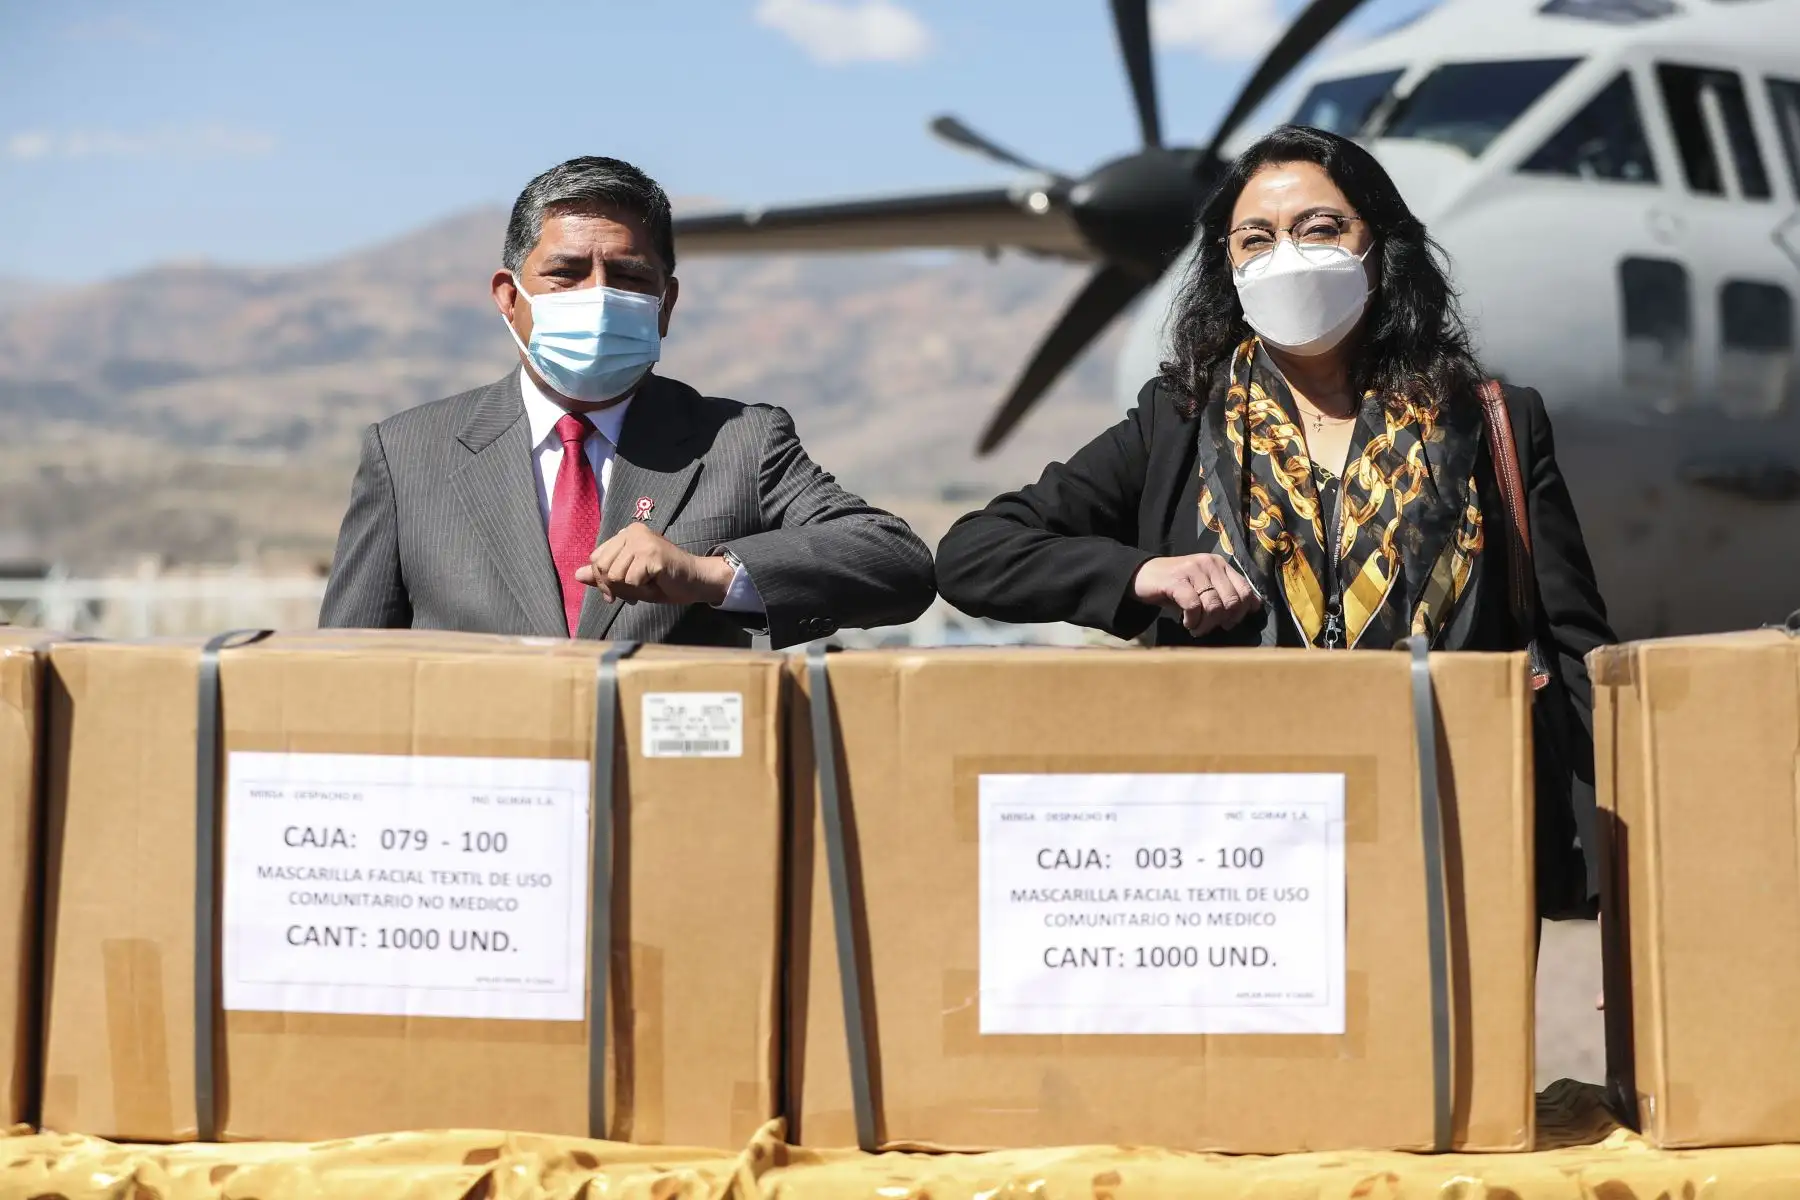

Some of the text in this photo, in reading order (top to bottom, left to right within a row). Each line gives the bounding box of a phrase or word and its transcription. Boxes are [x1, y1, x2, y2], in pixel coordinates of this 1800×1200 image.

[284, 825, 356, 848] CAJA:
[381, 829, 428, 850] 079
[462, 831, 508, 853] 100
[1037, 848, 1111, 869] CAJA:
[1136, 847, 1183, 869] 003
[1217, 847, 1264, 868] 100
[257, 865, 552, 888] MASCARILLA FACIAL TEXTIL DE USO
[289, 891, 519, 912] COMUNITARIO NO MEDICO
[1010, 887, 1310, 902] MASCARILLA FACIAL TEXTIL DE USO
[1044, 912, 1276, 927] COMUNITARIO NO MEDICO
[286, 925, 518, 952] CANT: 1000 UND.
[1043, 946, 1277, 968] CANT: 1000 UND.
